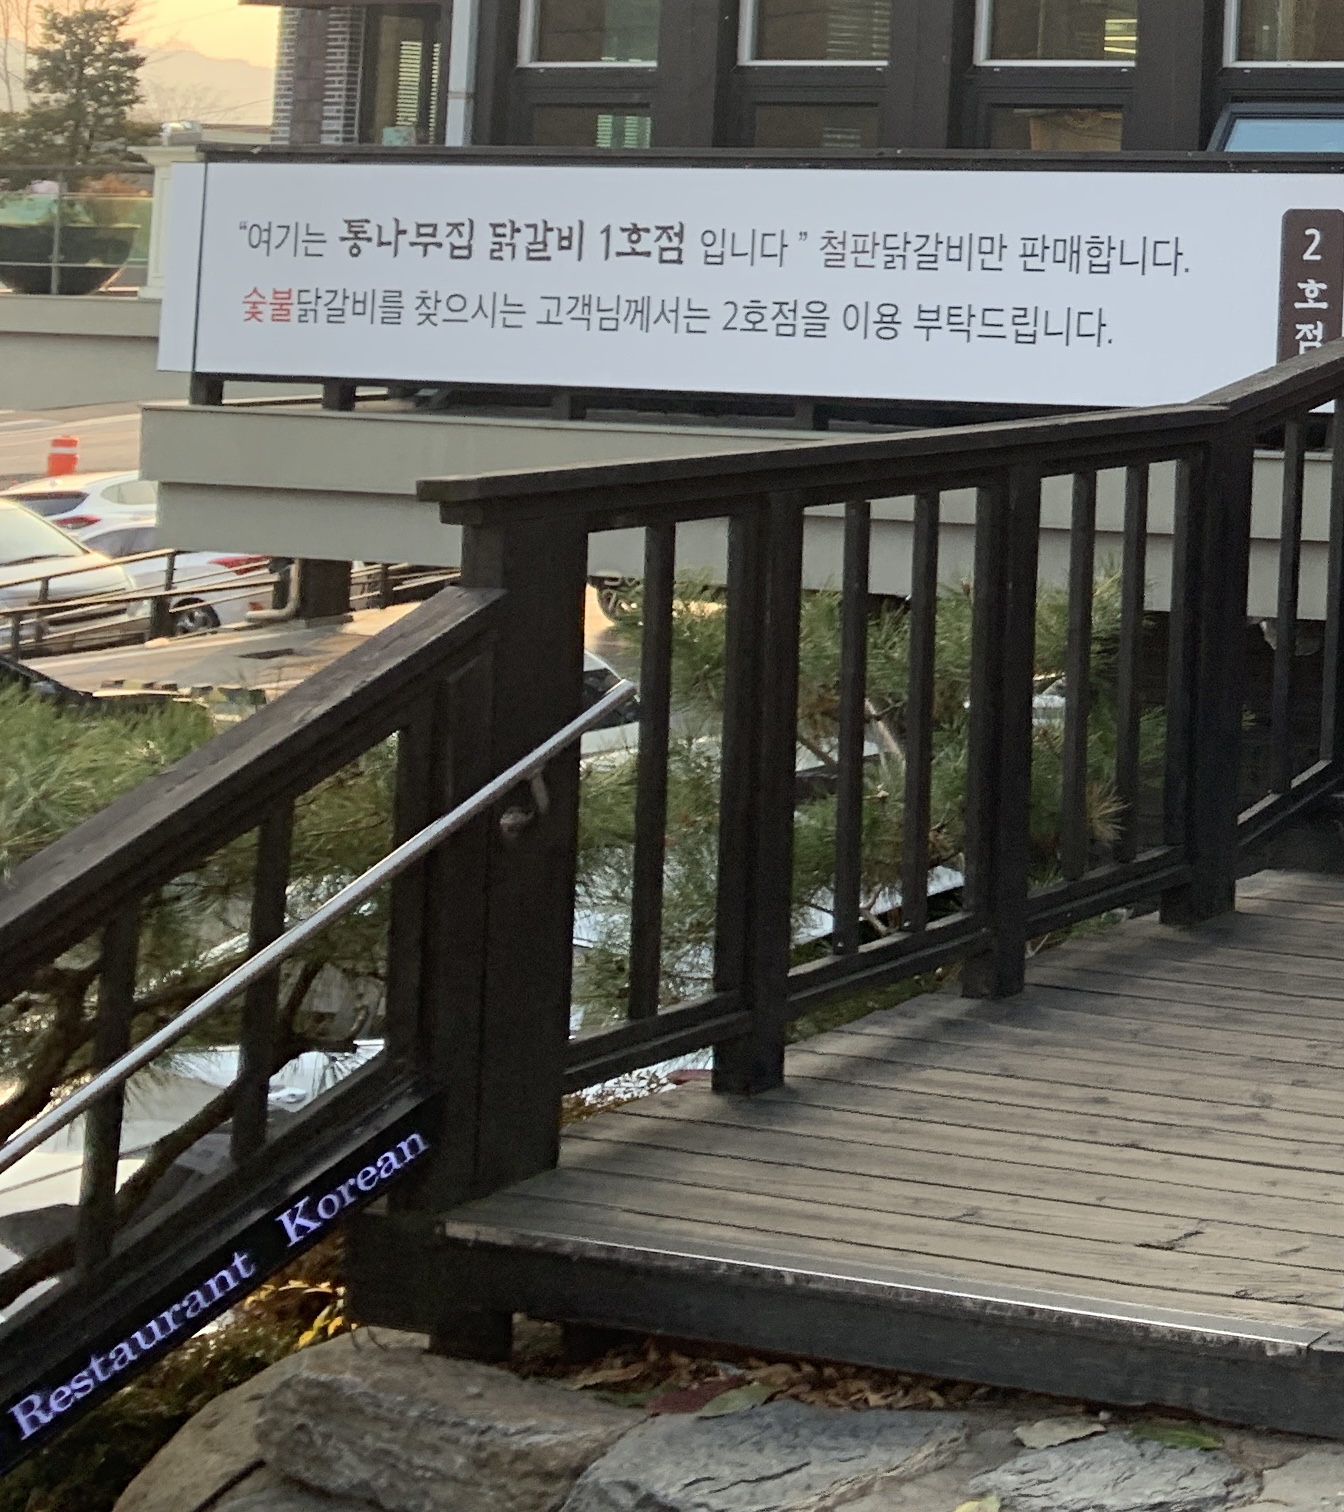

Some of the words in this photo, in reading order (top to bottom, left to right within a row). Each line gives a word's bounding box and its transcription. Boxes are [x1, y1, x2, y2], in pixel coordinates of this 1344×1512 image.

[338, 217, 474, 261] 통나무집
[488, 219, 584, 264] 닭갈비
[599, 221, 685, 266] 1호점
[819, 229, 1007, 274] 철판닭갈비만
[1018, 232, 1191, 277] 판매합니다.
[242, 286, 405, 326] 숯불닭갈비를
[414, 291, 526, 331] 찾으시는
[536, 293, 711, 335] 고객님께서는
[721, 297, 829, 339] 2호점을
[843, 300, 901, 342] 이용
[913, 303, 1113, 348] 부탁드립니다.
[8, 1250, 256, 1440] Restaurant
[276, 1131, 429, 1248] Korean
